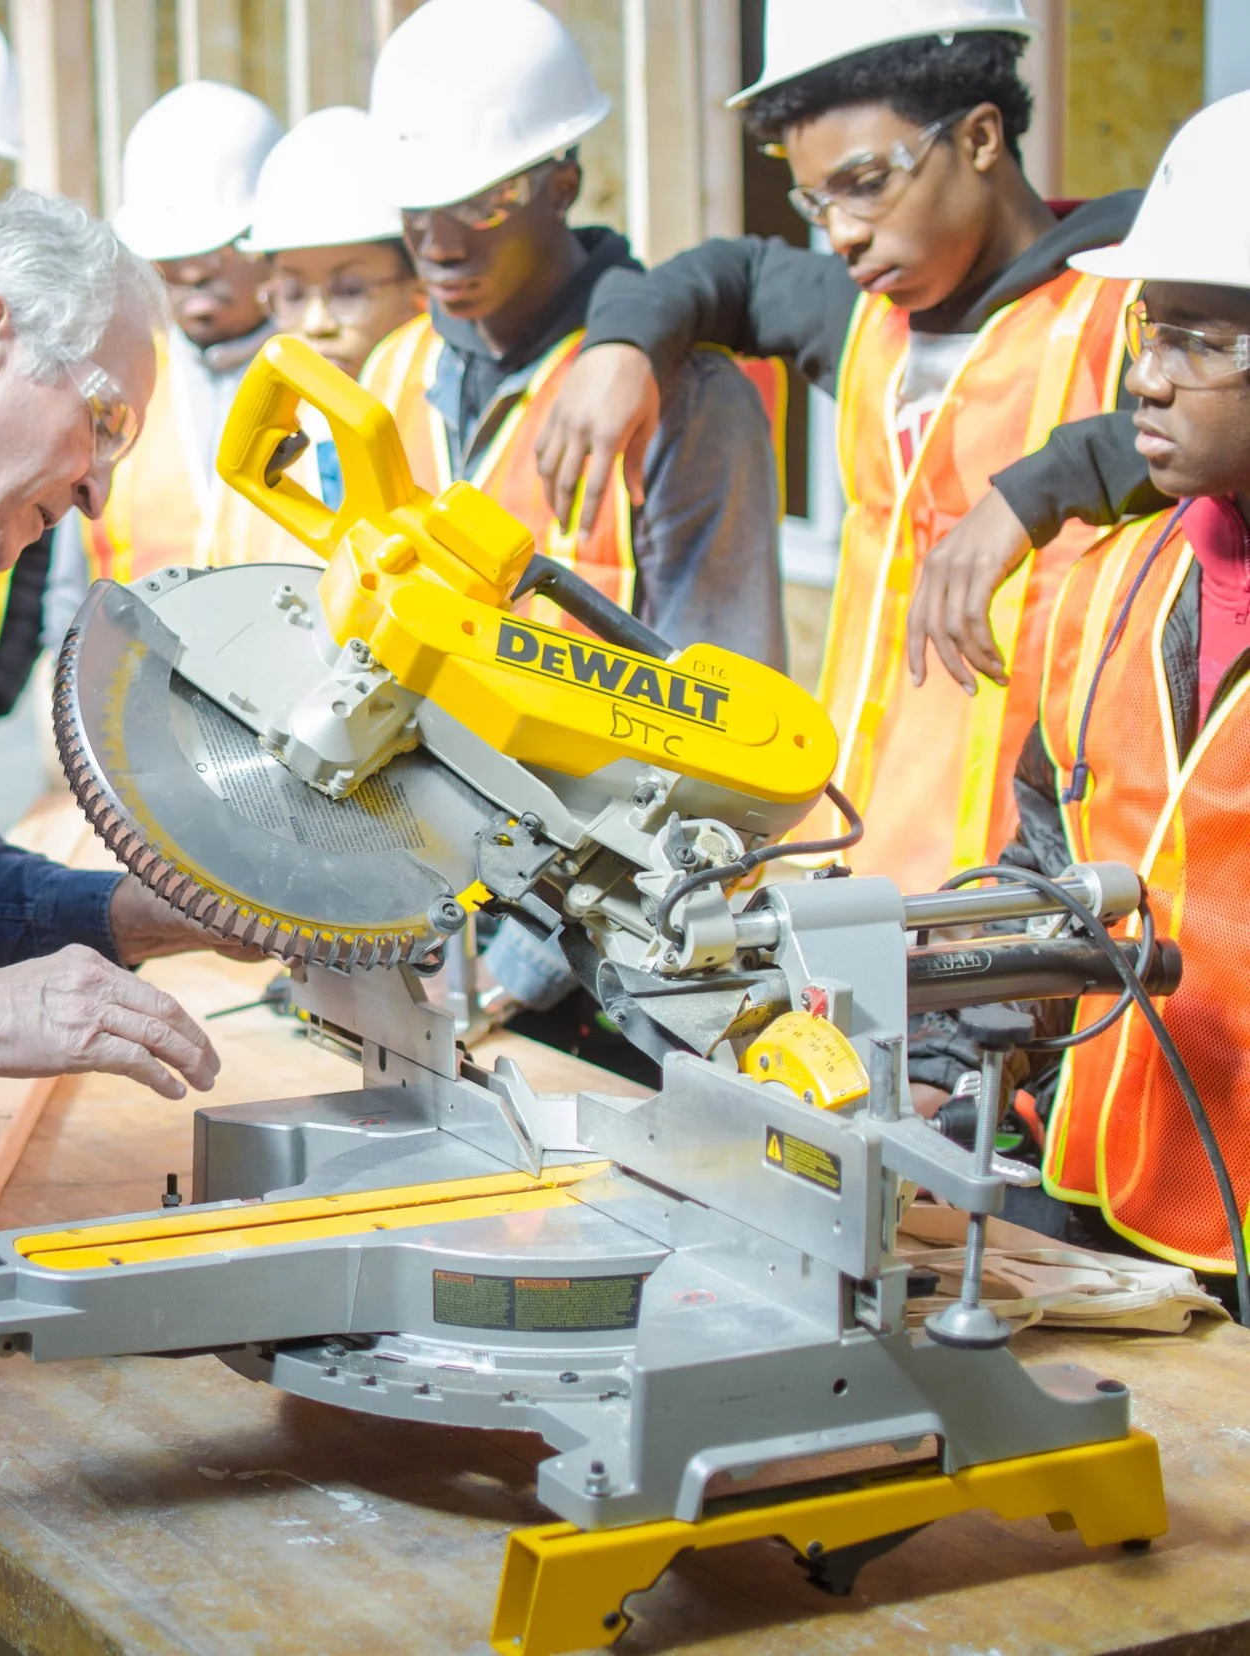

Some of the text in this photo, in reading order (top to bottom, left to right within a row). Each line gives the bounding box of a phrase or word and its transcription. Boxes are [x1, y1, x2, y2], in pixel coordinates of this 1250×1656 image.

[496, 622, 729, 726] DEWALT
[693, 660, 727, 680] DTC
[610, 703, 684, 757] DTC
[809, 1042, 820, 1052] 30
